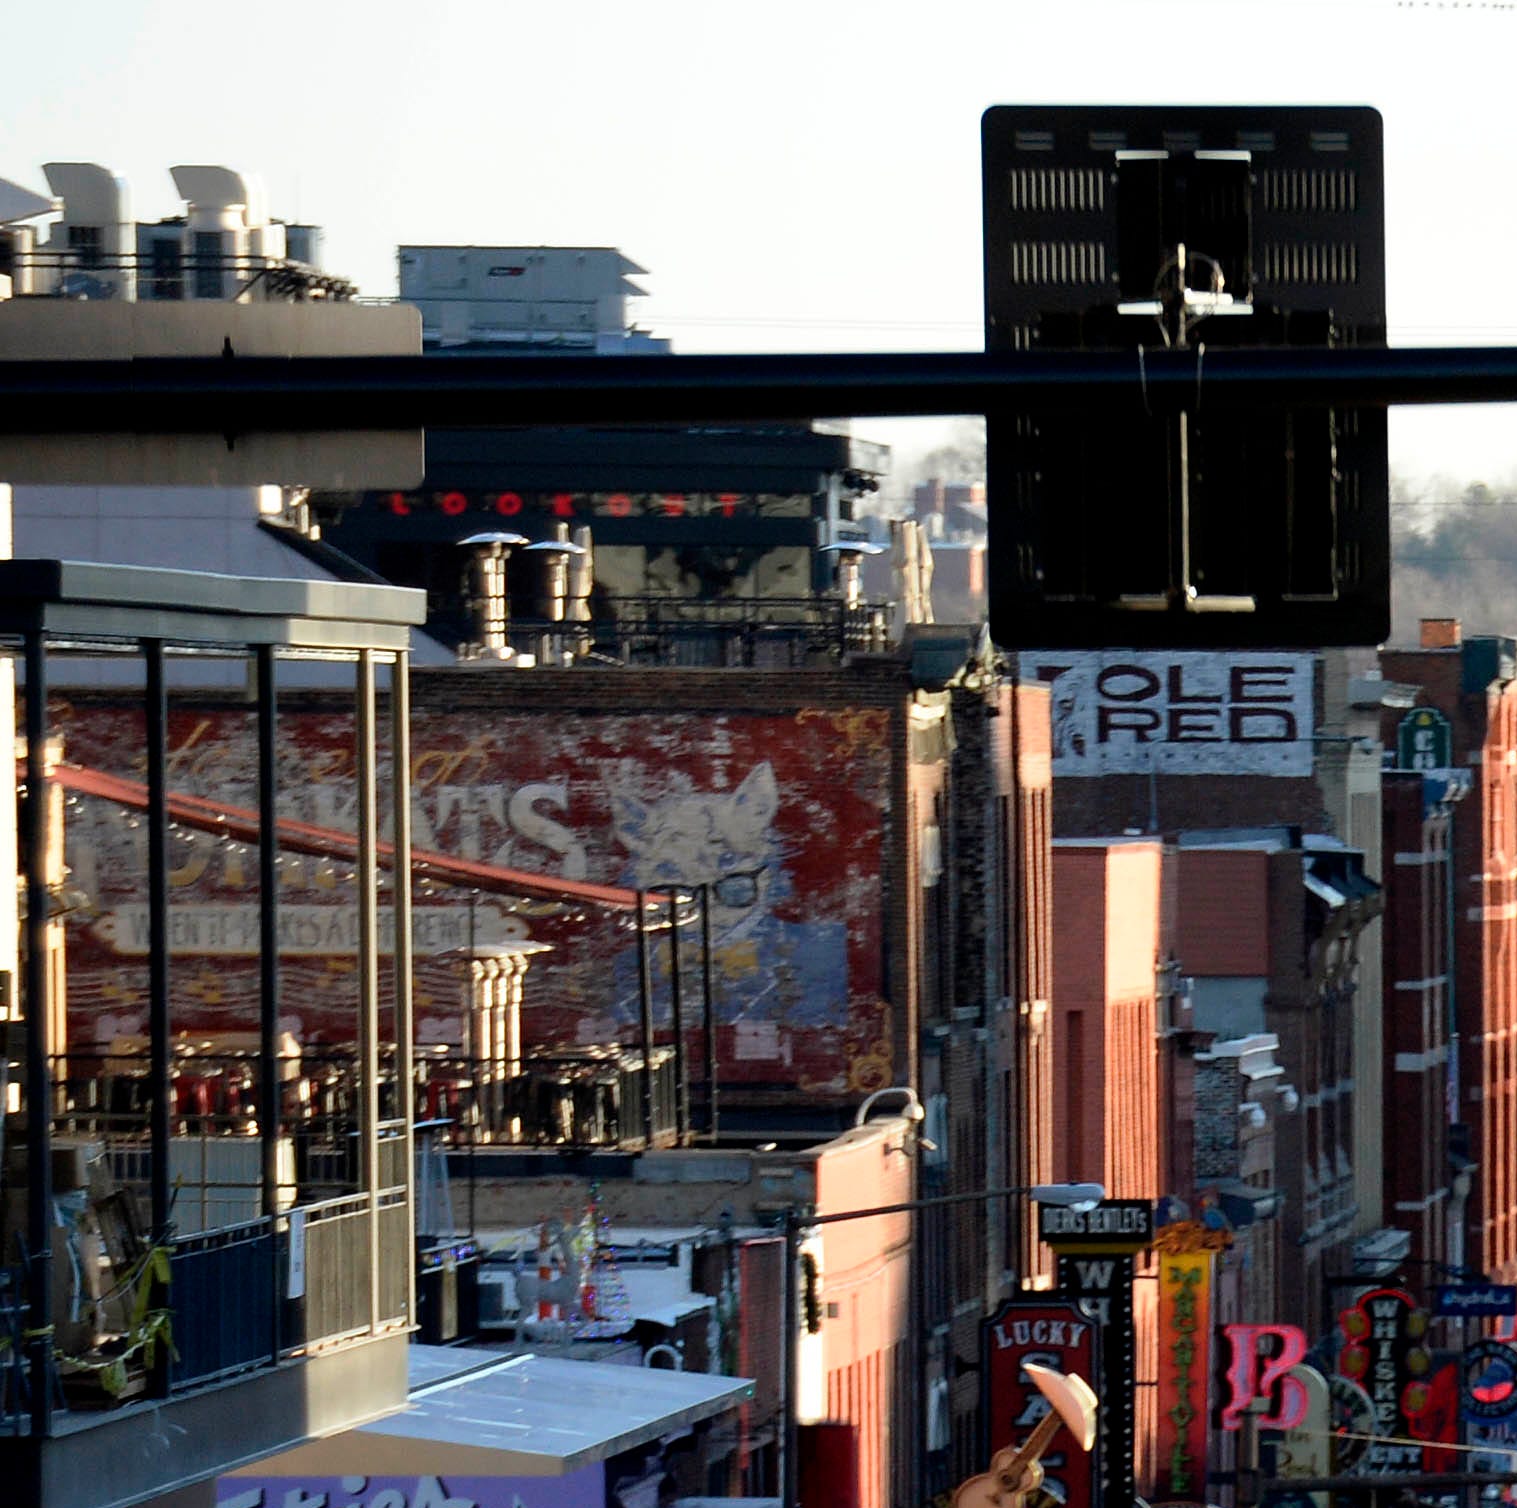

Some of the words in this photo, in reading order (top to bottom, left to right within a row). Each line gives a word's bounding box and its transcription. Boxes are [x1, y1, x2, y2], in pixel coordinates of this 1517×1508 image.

[1096, 664, 1295, 703] OLE
[1096, 704, 1298, 744] RED
[994, 1319, 1089, 1350] LUCKY
